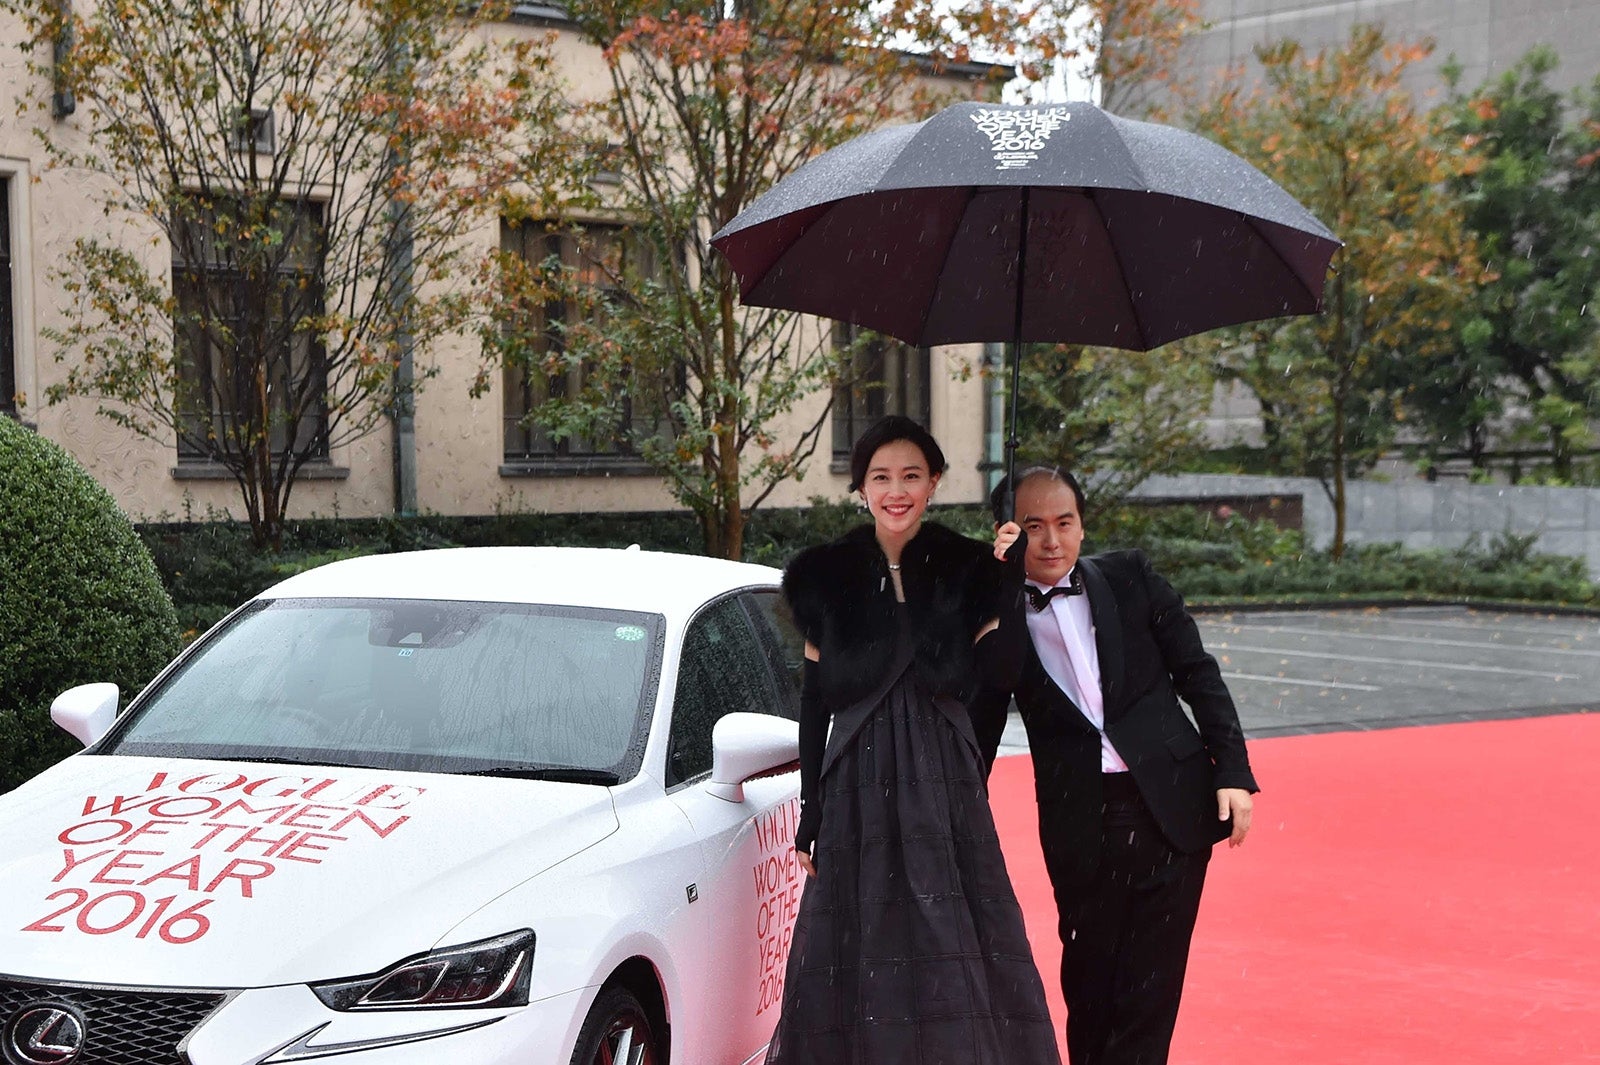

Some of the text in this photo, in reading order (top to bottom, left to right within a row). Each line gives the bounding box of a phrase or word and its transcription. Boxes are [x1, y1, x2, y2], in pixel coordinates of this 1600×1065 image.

[977, 120, 1061, 132] OF THE
[984, 130, 1050, 140] YEAR
[991, 139, 1046, 151] 2016
[146, 772, 427, 810] VOGUE
[82, 795, 411, 839] WOMEN
[58, 820, 349, 864] OF THE
[52, 849, 276, 898] YEAR
[20, 888, 215, 945] 2016
[757, 883, 799, 940] OF THE
[759, 926, 791, 977] YEAR
[756, 967, 783, 1017] 2016
